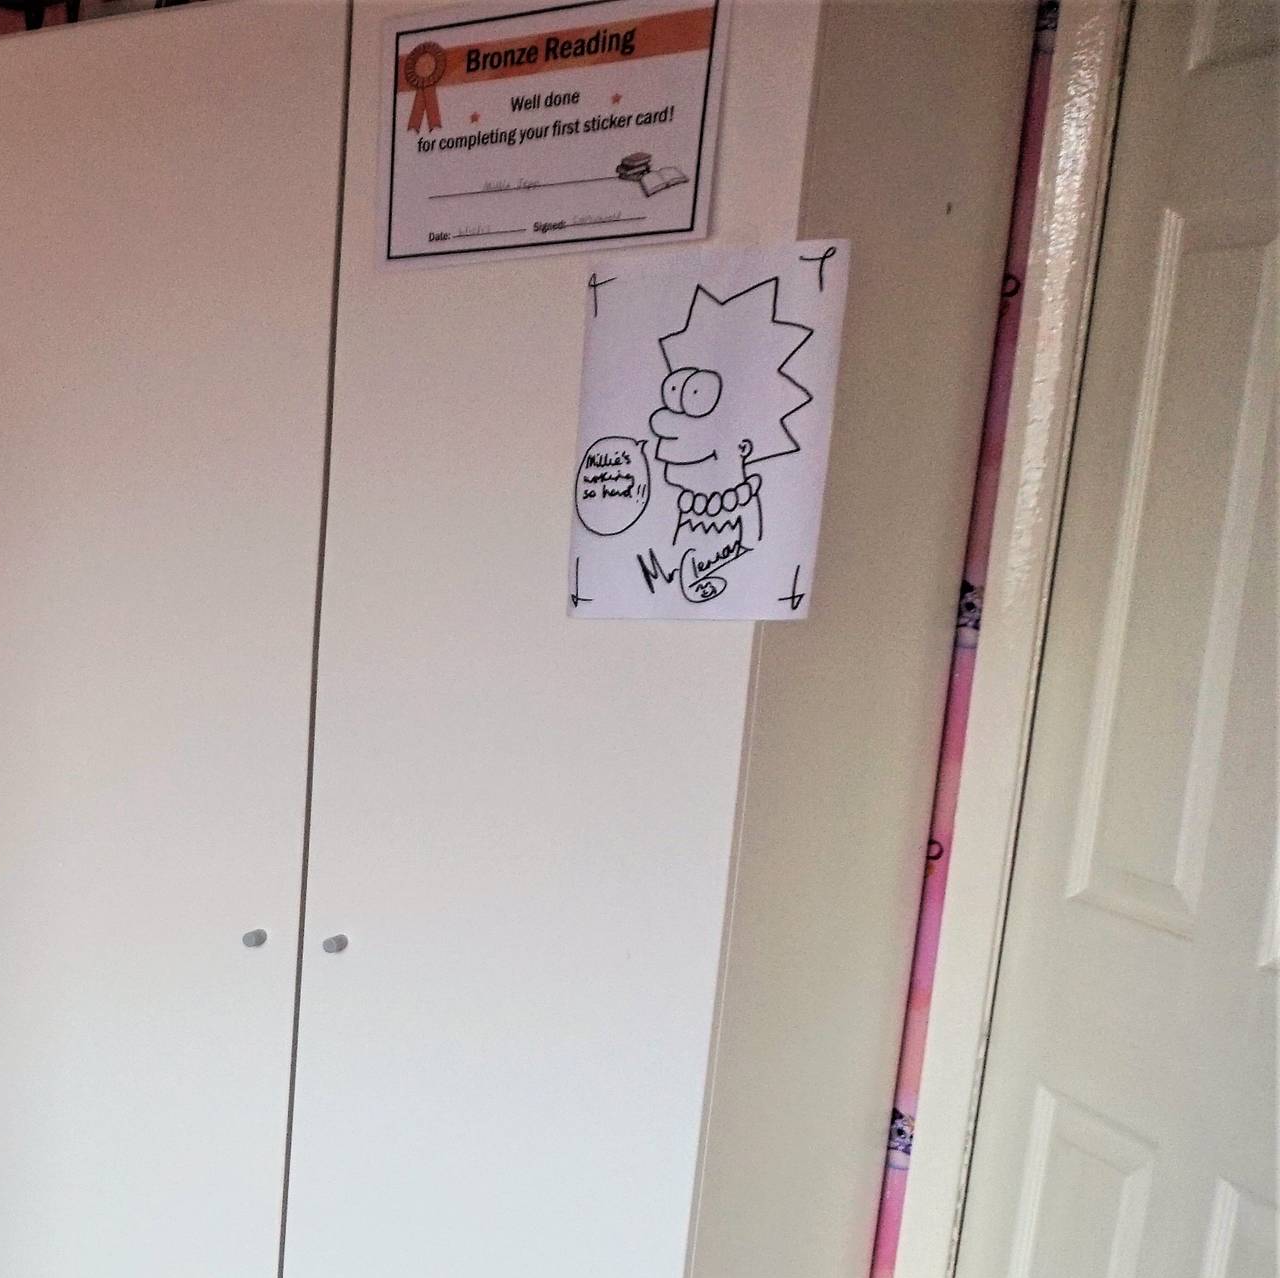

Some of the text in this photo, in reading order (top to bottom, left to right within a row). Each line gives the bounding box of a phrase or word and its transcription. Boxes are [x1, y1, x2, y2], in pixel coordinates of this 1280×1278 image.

[466, 27, 637, 73] Bronze Reading
[511, 91, 580, 112] Well done
[418, 105, 675, 152] for completing your first sticker card!
[428, 231, 451, 243] Date:
[636, 547, 681, 594] Mr
